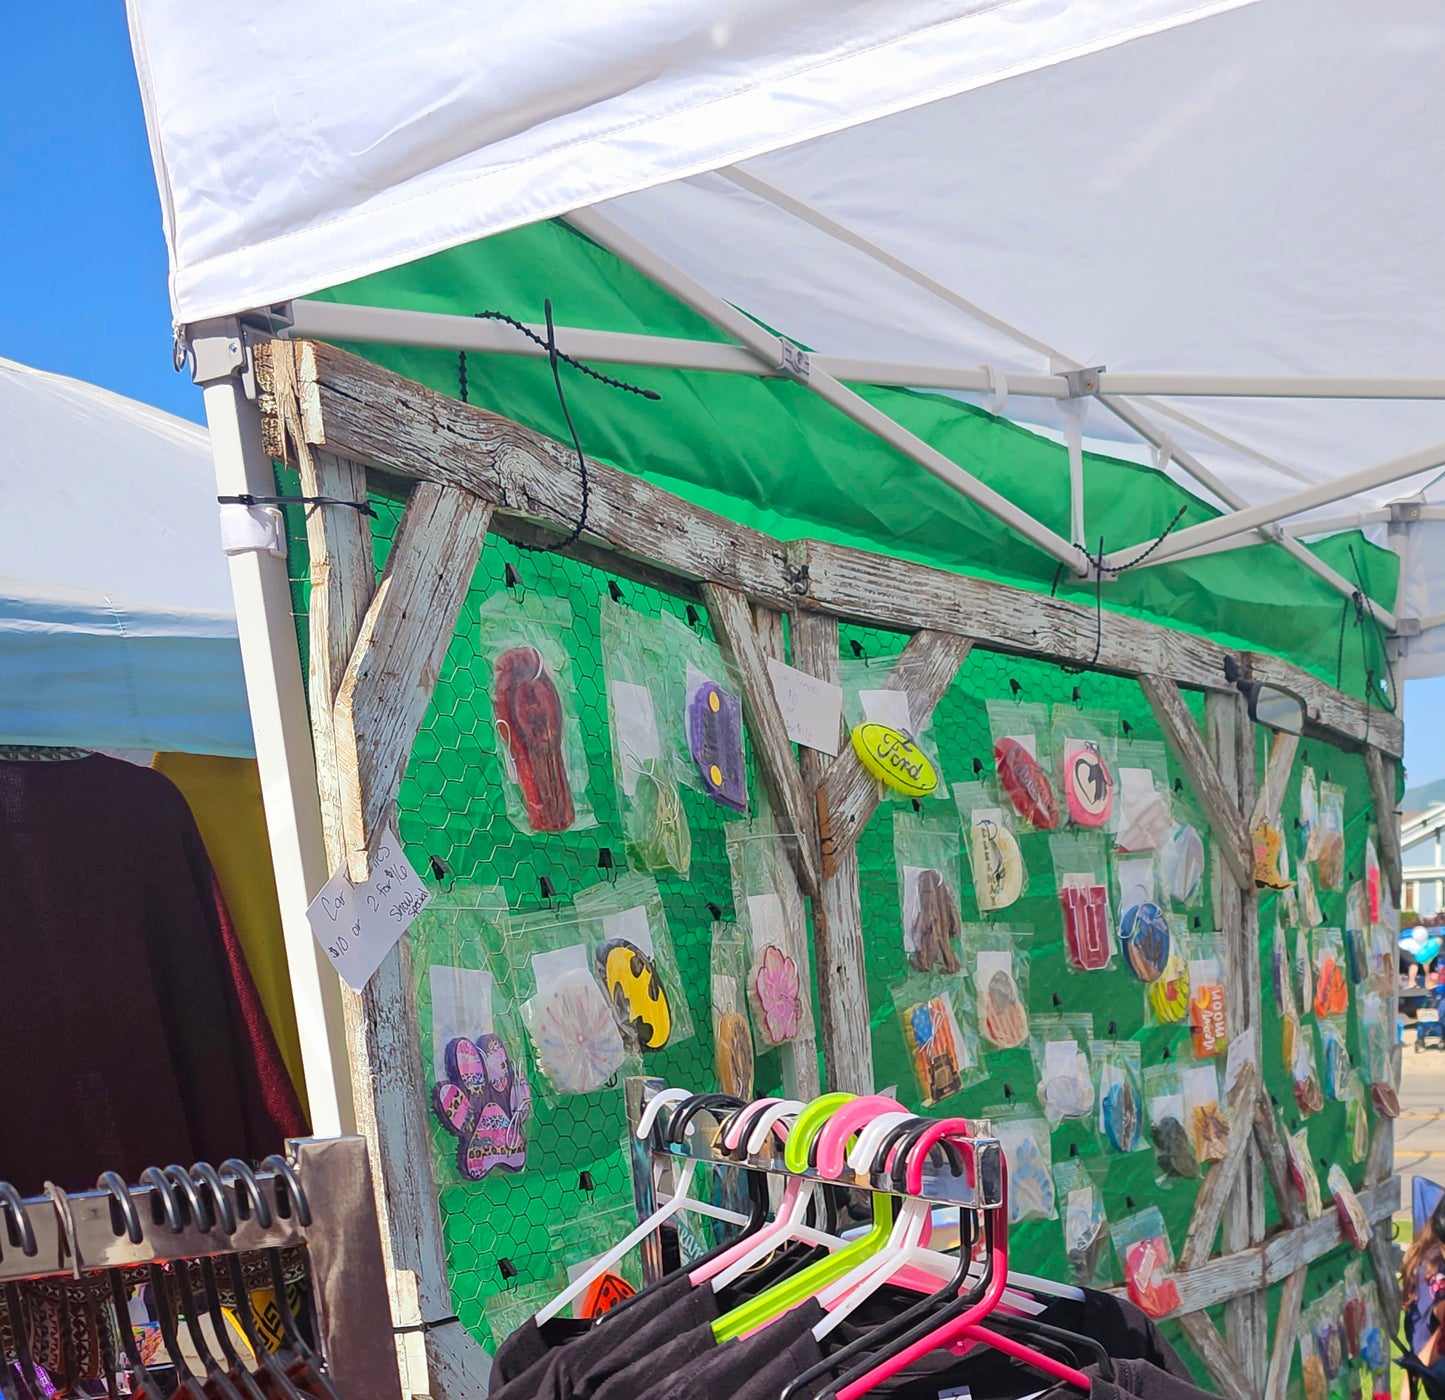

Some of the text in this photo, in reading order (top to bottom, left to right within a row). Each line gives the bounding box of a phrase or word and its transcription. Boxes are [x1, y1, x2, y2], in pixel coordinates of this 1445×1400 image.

[876, 732, 926, 781] Ford
[321, 888, 346, 922] Car
[327, 864, 409, 960] $10 or 2 for $16
[1211, 989, 1225, 1038] moon
